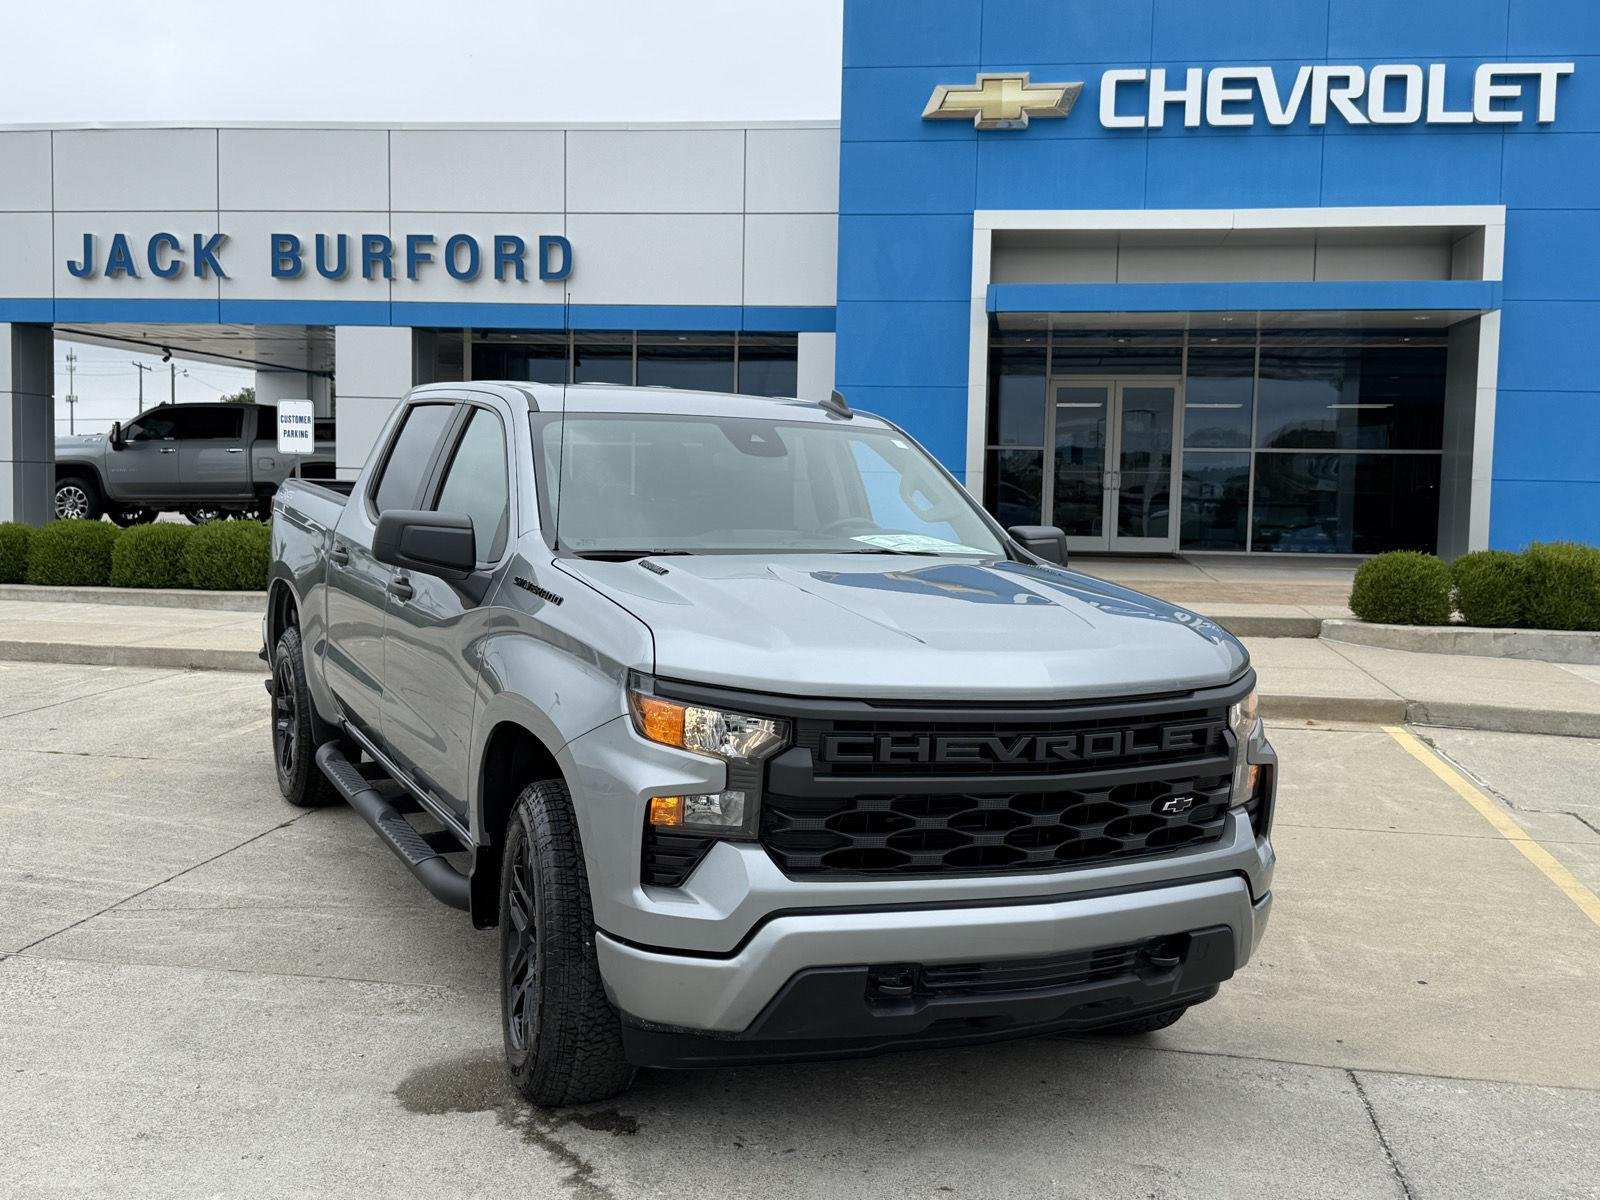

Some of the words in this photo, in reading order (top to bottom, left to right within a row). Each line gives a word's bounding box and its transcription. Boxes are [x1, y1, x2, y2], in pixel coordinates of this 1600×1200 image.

[1099, 62, 1575, 129] CHEVROLET
[67, 233, 228, 279] JACK
[271, 233, 572, 281] BURFORD
[280, 414, 312, 424] CUSTOMER
[283, 430, 309, 439] PARKING
[823, 720, 1226, 764] CHEVROLET
